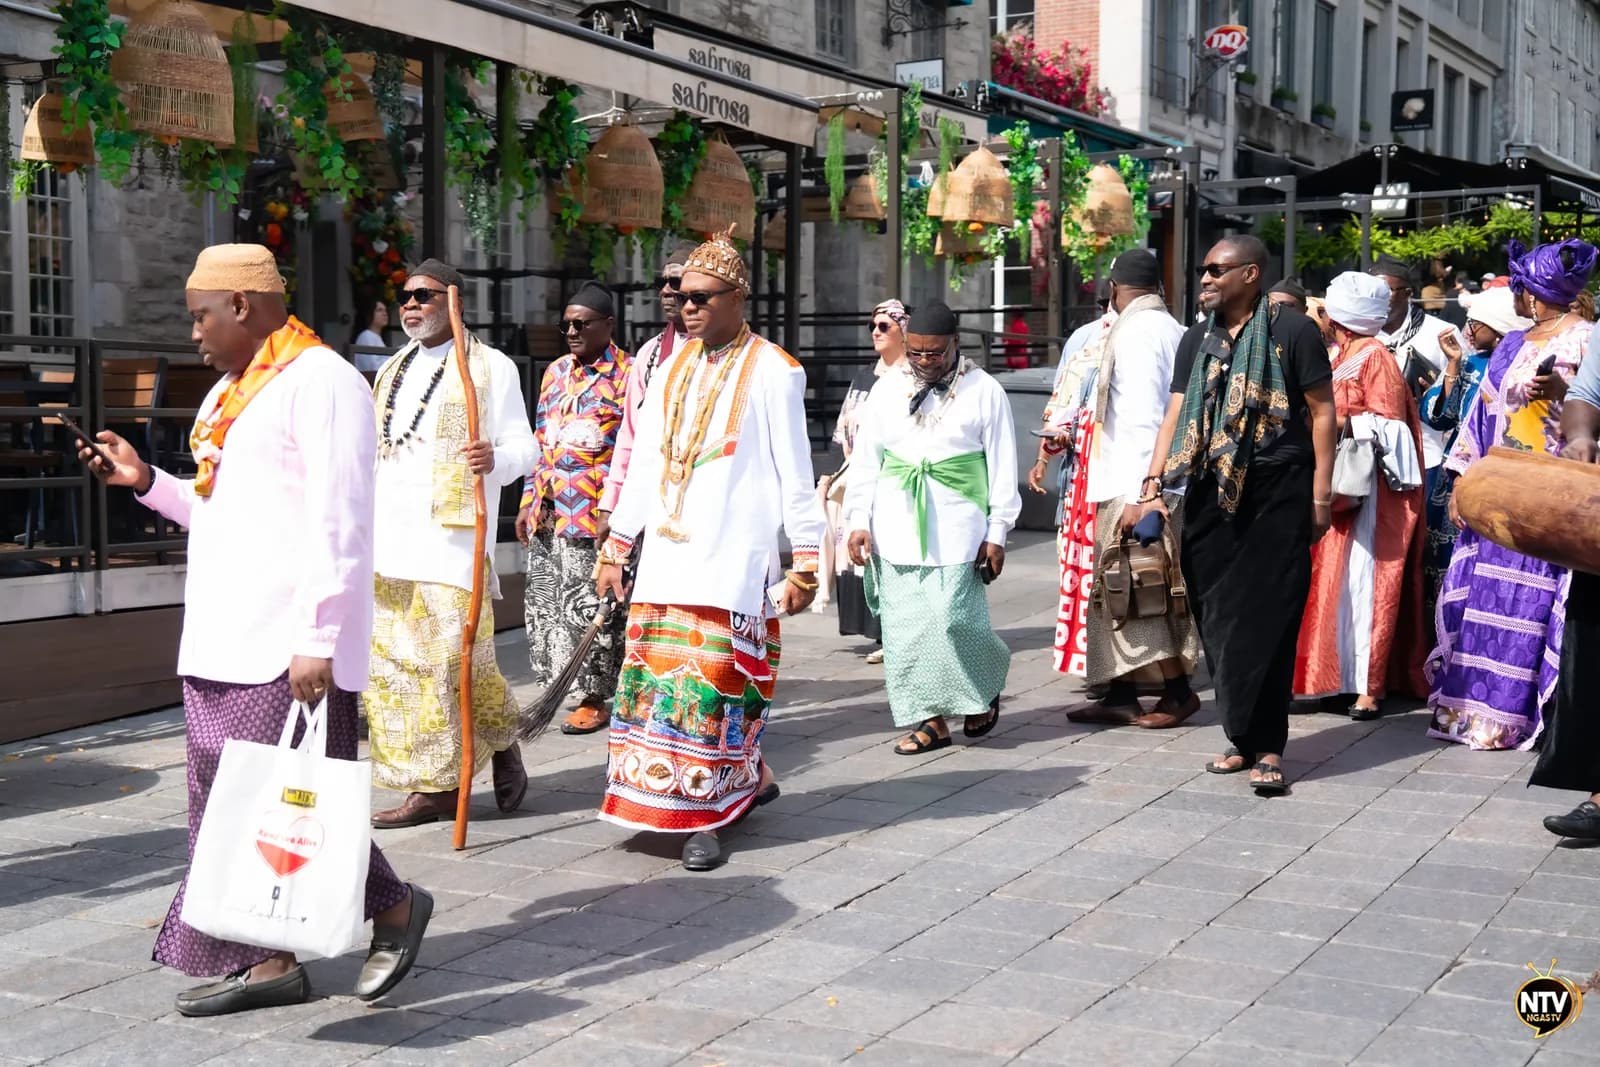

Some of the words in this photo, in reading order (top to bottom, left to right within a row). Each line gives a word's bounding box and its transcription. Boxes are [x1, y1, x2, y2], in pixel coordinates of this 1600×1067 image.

[1211, 31, 1242, 48] DQ
[688, 46, 751, 81] sabrosa
[900, 72, 940, 89] Mna
[672, 81, 750, 127] sabrosa
